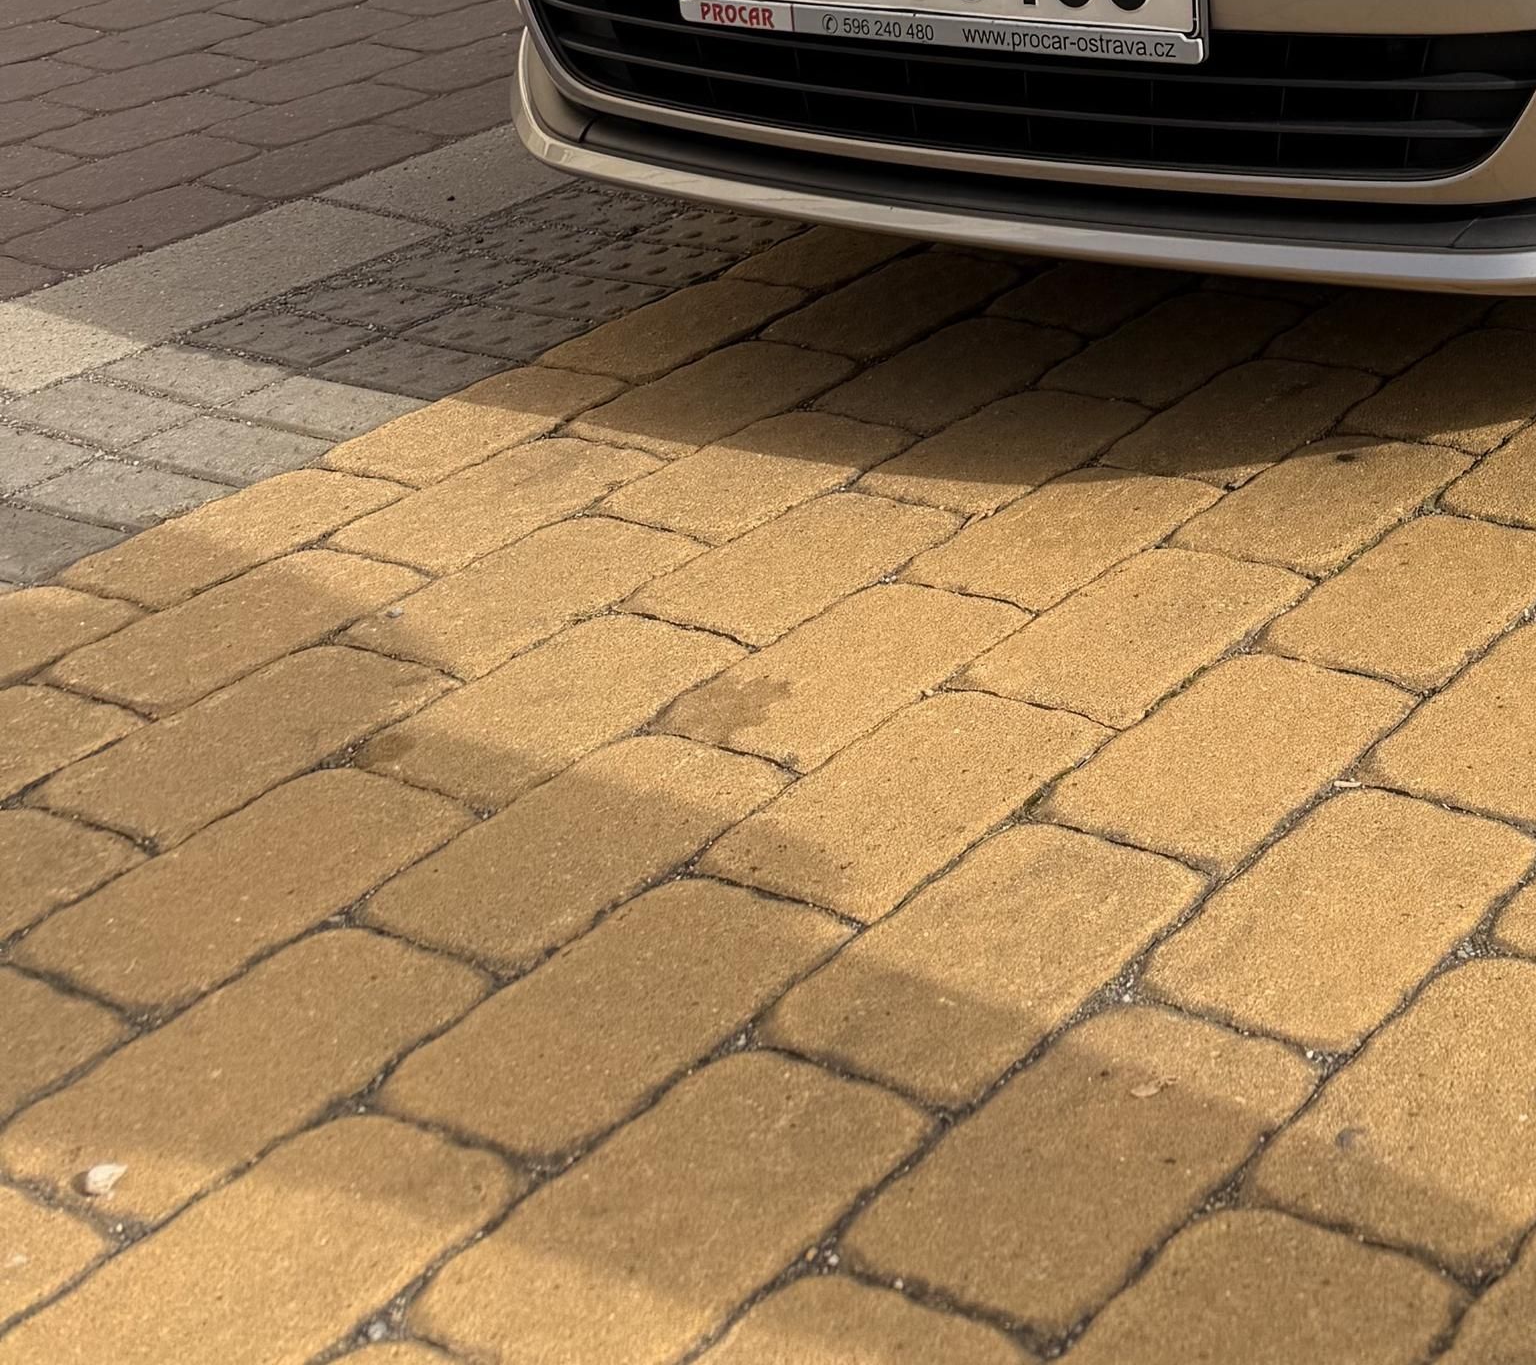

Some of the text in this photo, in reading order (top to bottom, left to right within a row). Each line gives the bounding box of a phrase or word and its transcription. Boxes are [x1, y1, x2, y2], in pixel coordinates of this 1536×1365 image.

[700, 1, 775, 29] PROCAR
[842, 17, 1177, 58] 596 240 480 www.procar-ostrava.cz
